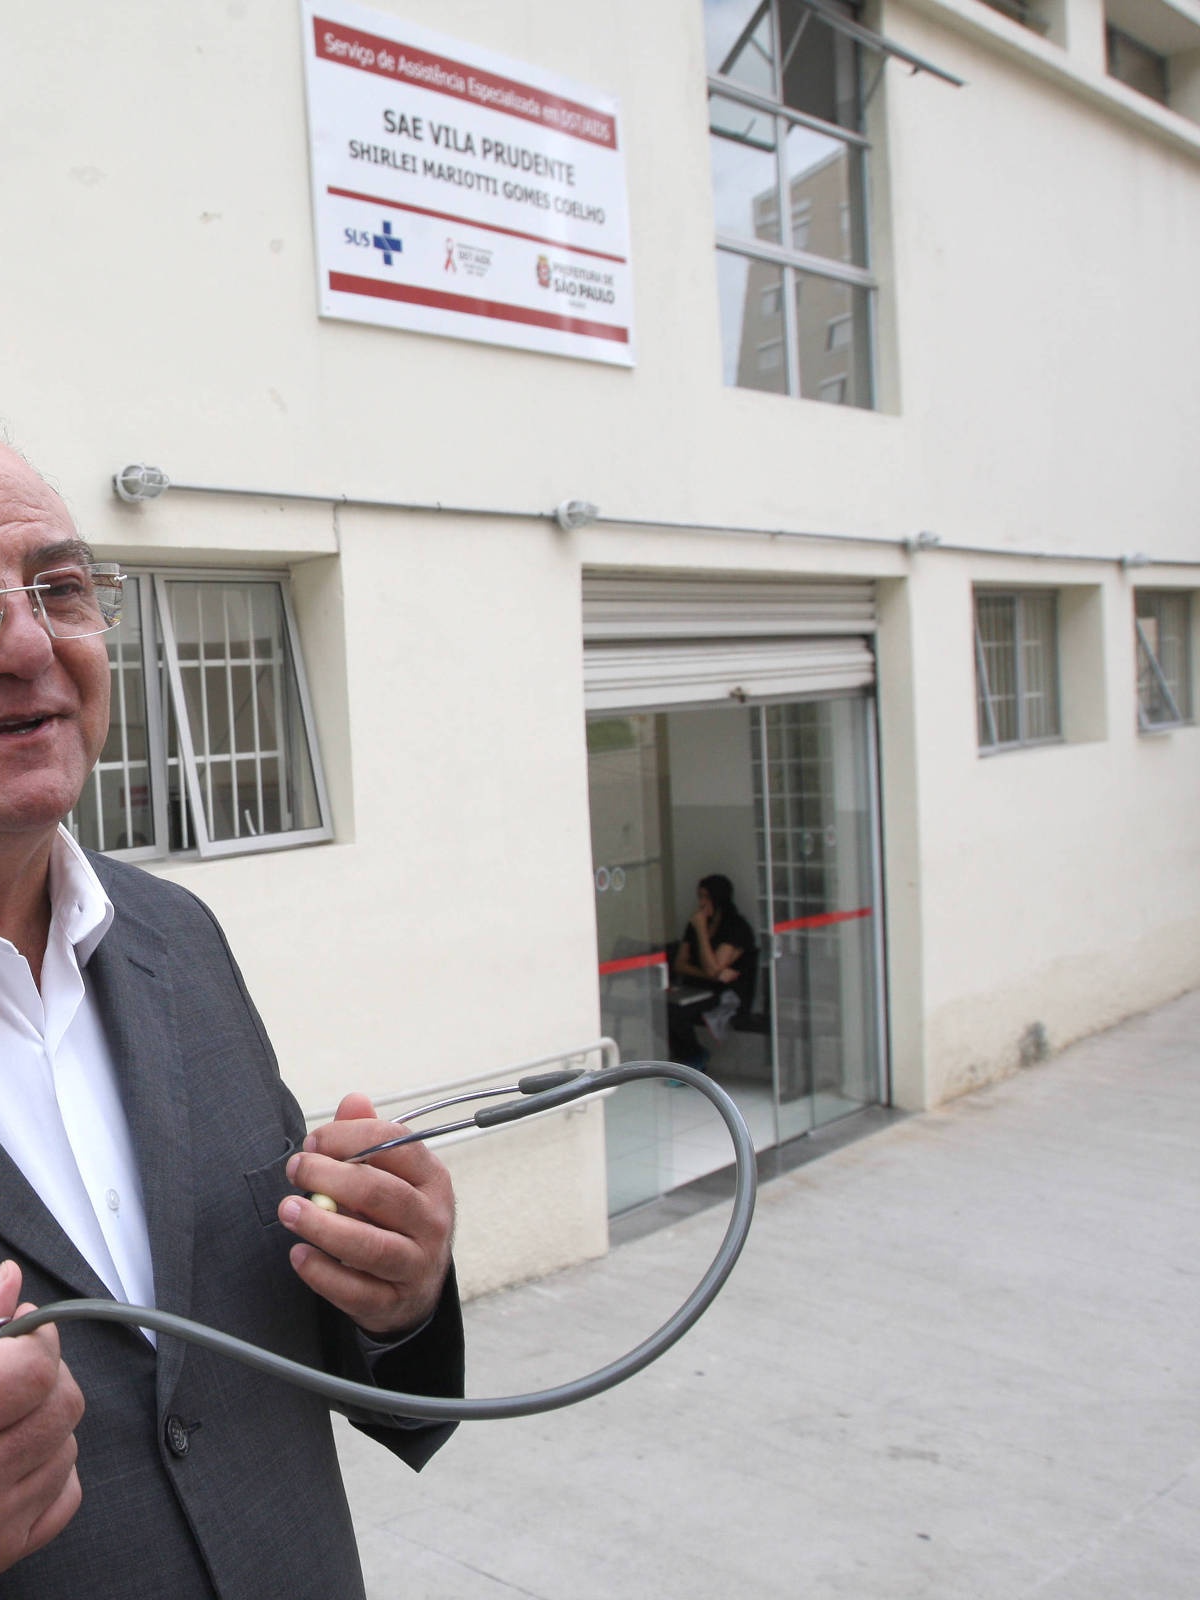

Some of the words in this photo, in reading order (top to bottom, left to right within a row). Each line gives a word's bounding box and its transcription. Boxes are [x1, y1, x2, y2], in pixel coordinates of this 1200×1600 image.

[323, 31, 376, 66] Serviço
[377, 49, 396, 72] de
[397, 56, 465, 92] Assistência
[467, 76, 540, 117] Especializada
[349, 140, 418, 174] SHIRLEI
[423, 160, 499, 196] MARIOTTI
[502, 181, 551, 210] GOMES
[554, 196, 606, 225] COELHO
[383, 109, 423, 141] SAE
[429, 122, 476, 157] VILA
[482, 138, 576, 187] PRUDENTE
[344, 227, 371, 248] SUS
[578, 283, 616, 305] PAULO
